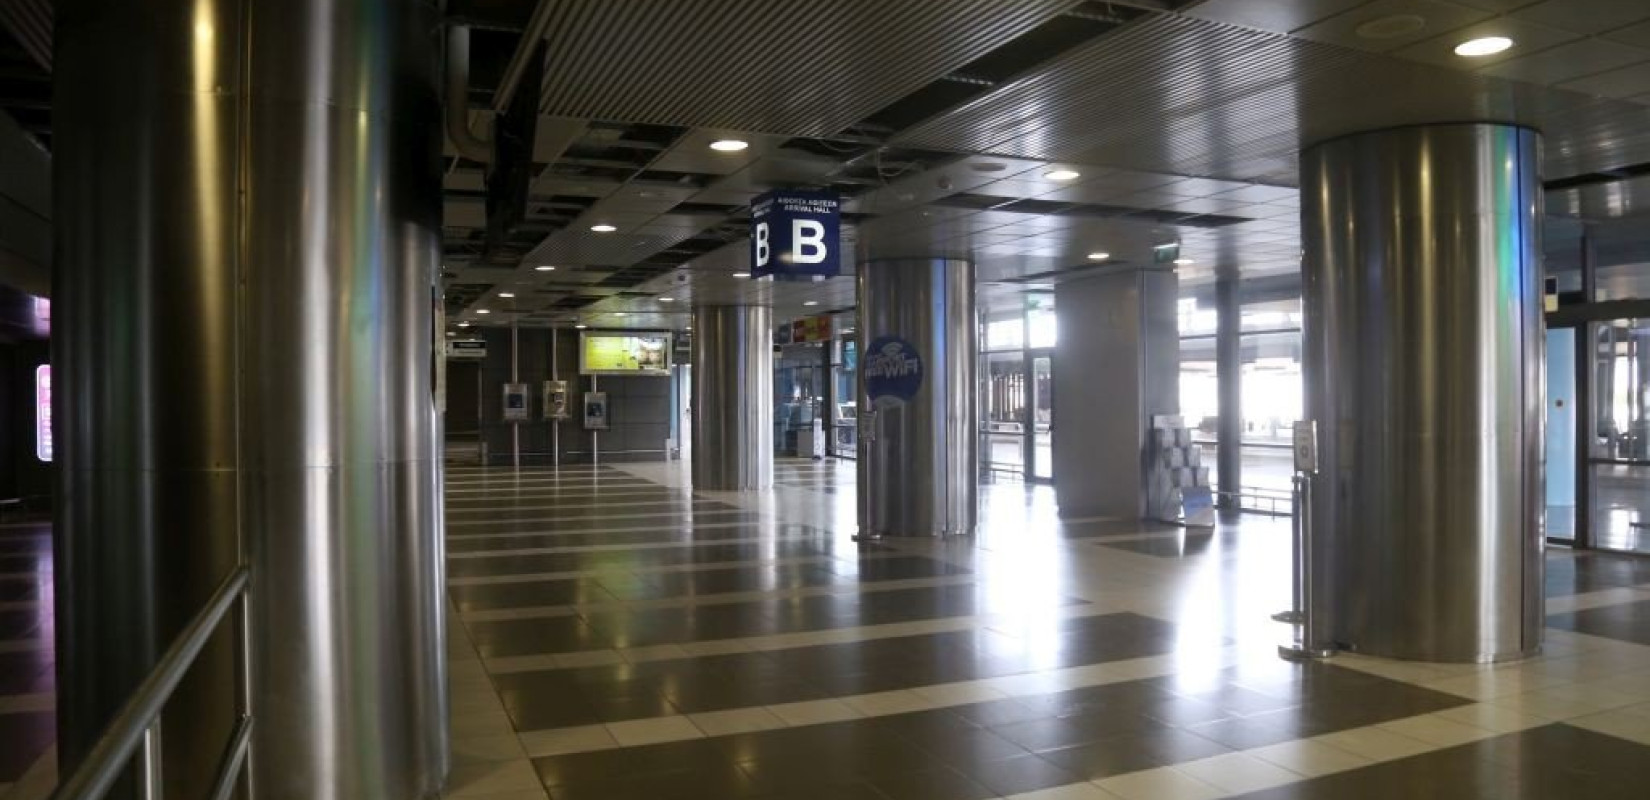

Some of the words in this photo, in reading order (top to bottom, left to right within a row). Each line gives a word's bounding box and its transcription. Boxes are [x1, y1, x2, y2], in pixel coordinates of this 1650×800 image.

[784, 204, 812, 213] ARRIVAL
[813, 206, 831, 214] HALL
[756, 222, 770, 267] B
[792, 219, 827, 264] B
